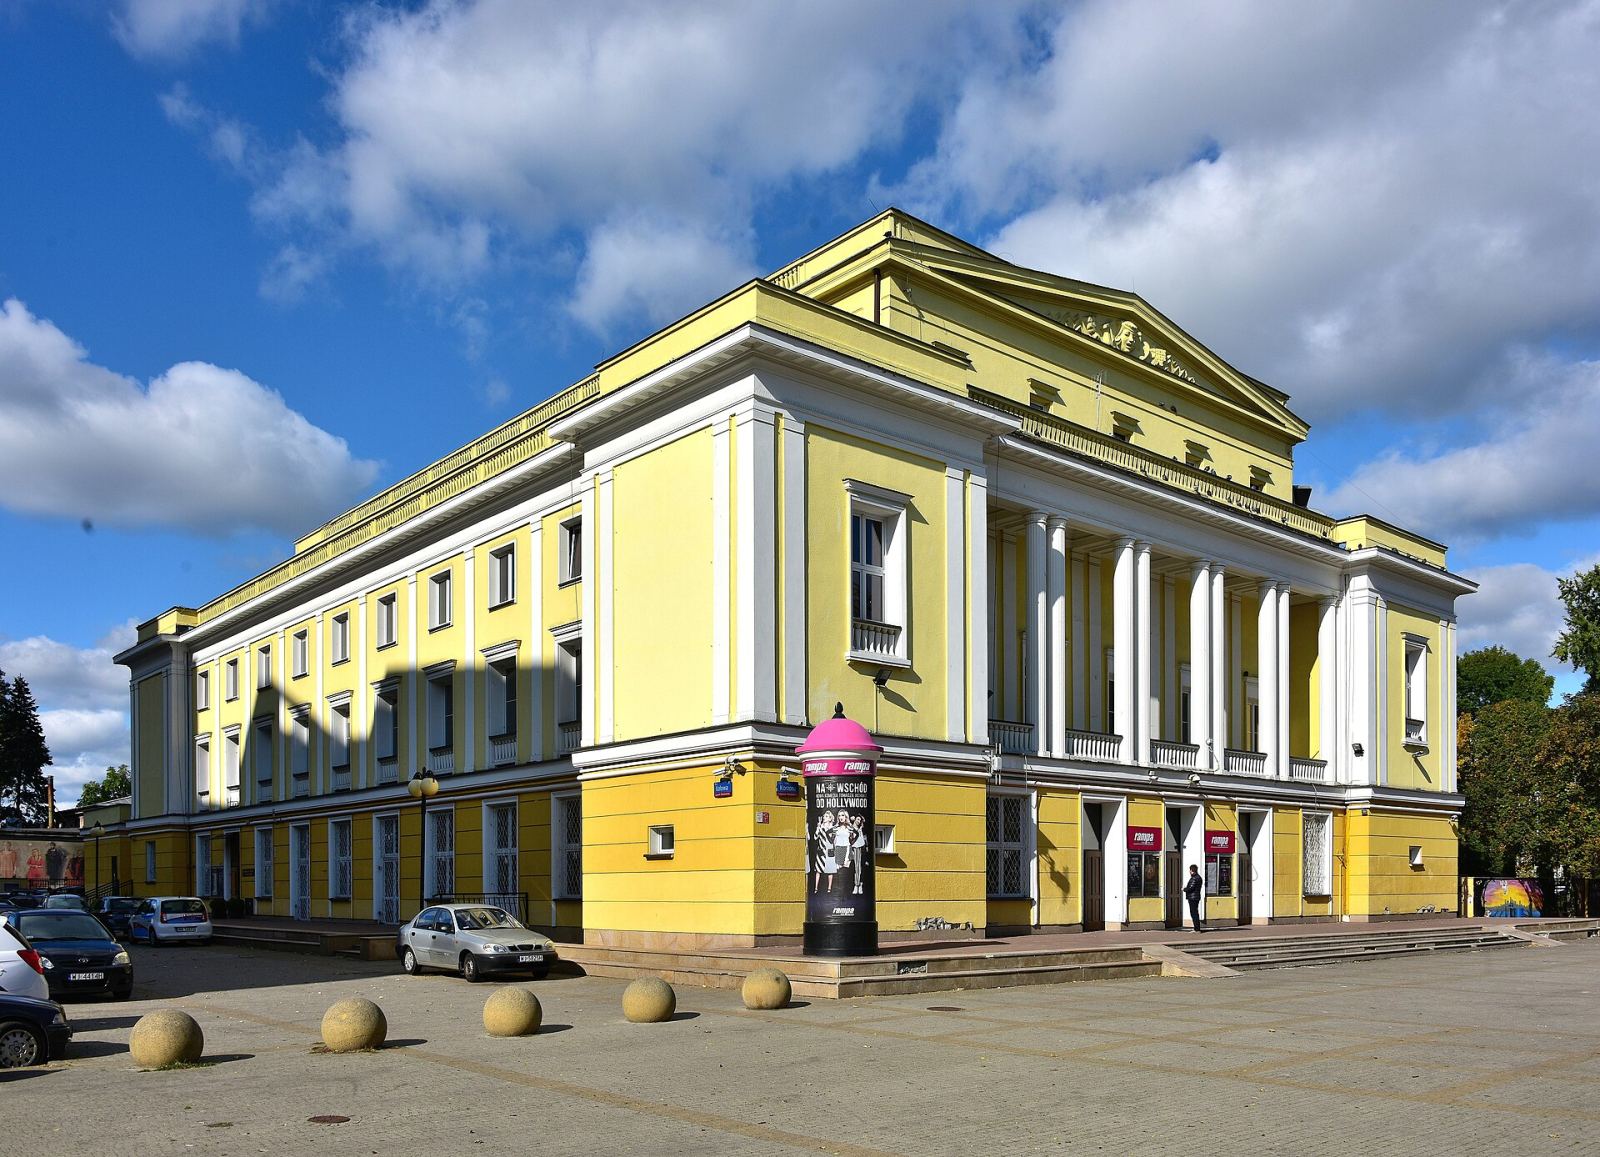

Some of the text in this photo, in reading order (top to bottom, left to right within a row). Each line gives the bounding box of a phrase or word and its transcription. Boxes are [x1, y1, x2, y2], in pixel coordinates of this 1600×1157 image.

[843, 761, 871, 773] rampa
[815, 781, 868, 793] NA WSCHÓD
[815, 798, 868, 808] OD HOLLYWOOD
[1133, 832, 1155, 845] rampa
[1211, 836, 1230, 848] rampa
[832, 907, 855, 915] rampa
